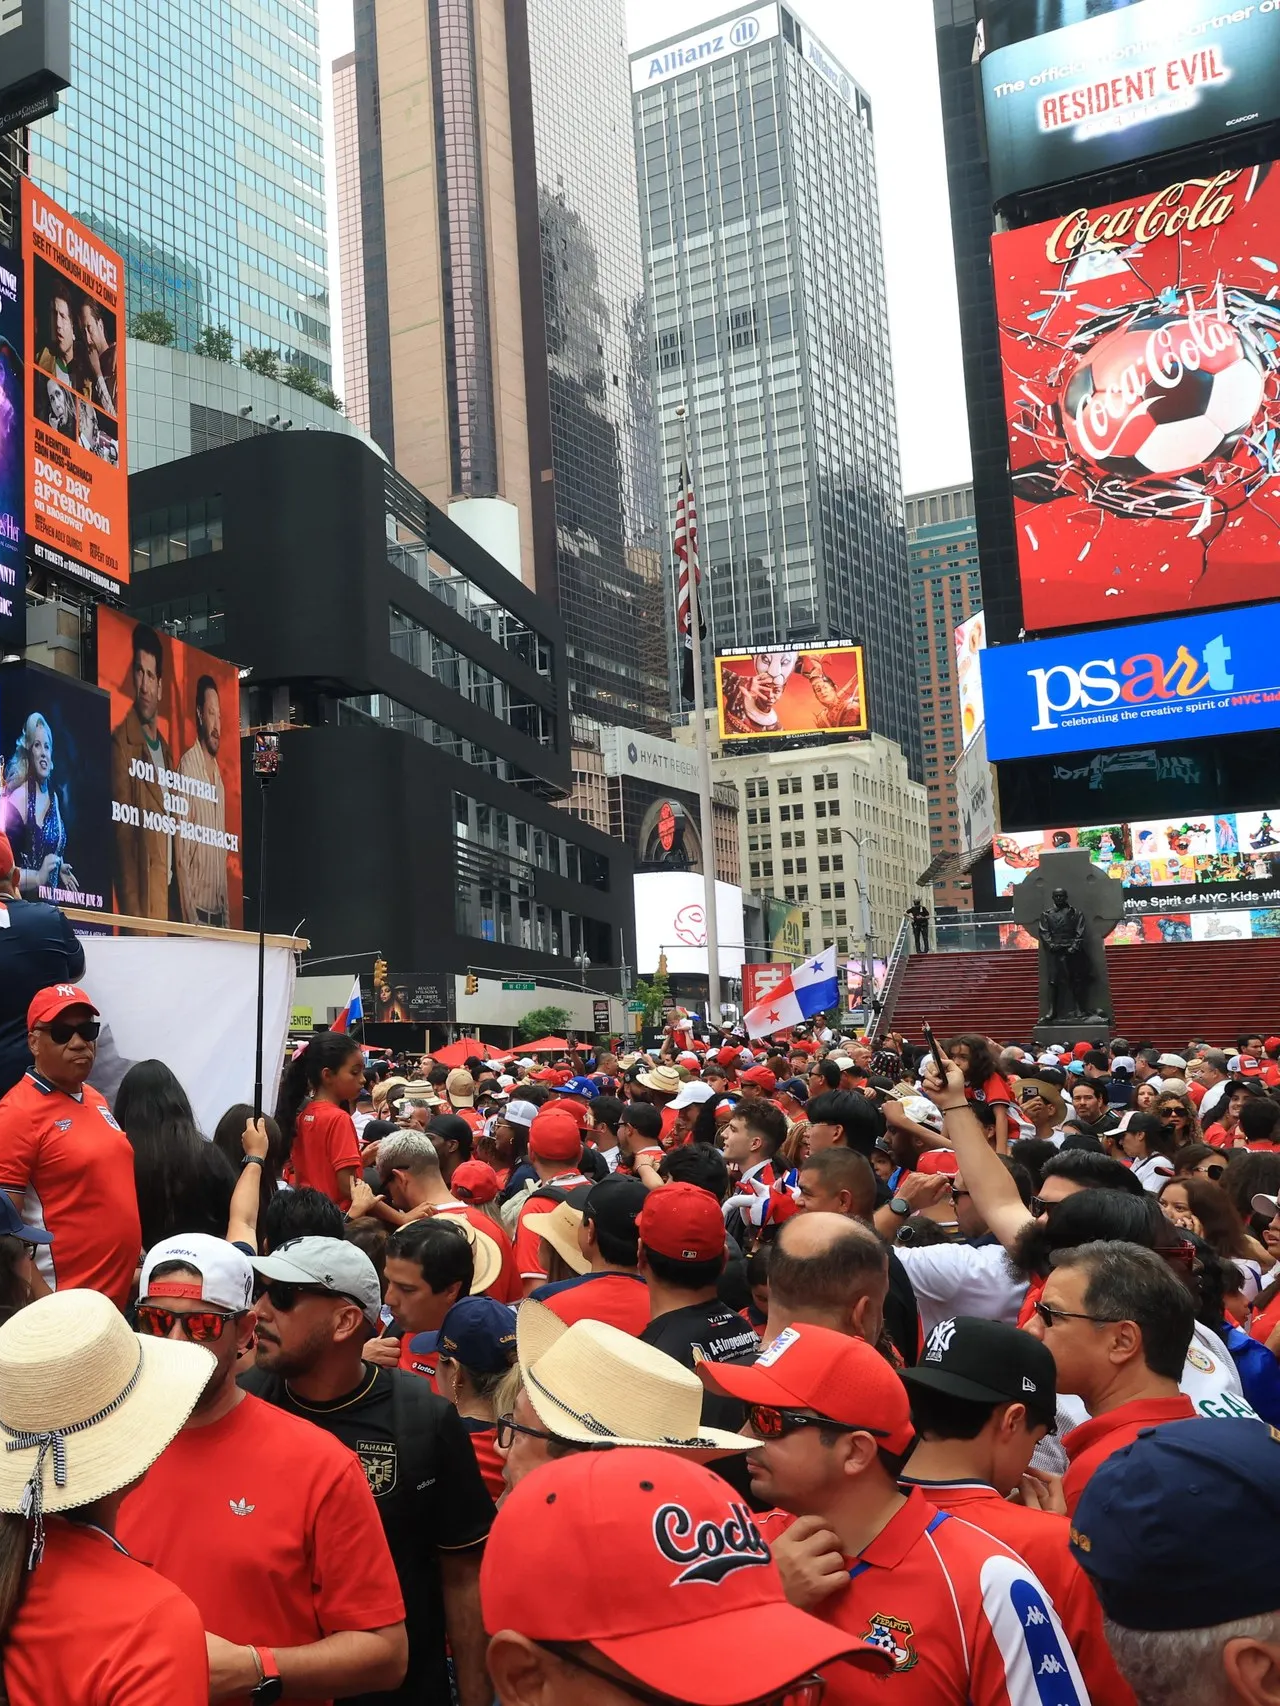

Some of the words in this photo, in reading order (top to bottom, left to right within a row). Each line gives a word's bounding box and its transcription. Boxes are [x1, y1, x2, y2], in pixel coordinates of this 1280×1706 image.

[647, 34, 725, 80] Allianz
[807, 39, 839, 89] Allianz
[993, 78, 1026, 99] The
[1041, 66, 1157, 129] RESIDENT
[1165, 48, 1224, 91] EVIL
[1045, 167, 1247, 265] Coca-Cola
[32, 199, 65, 248] LAST
[65, 227, 117, 292] CHANCE!
[32, 231, 44, 249] SEE
[52, 247, 82, 282] THROUGH
[80, 271, 96, 293] JULY
[95, 279, 104, 297] 12
[103, 288, 117, 308] ONLY
[1075, 300, 1233, 460] Coca-Cola
[35, 427, 45, 444] JON
[45, 433, 72, 460] BERNTHAL
[34, 441, 50, 459] EBON
[50, 448, 93, 484] MOSS-BACHRACH
[34, 457, 63, 488] DOG
[3, 512, 20, 544] Her
[34, 522, 55, 541] STEPHEN
[34, 543, 45, 558] GET
[44, 548, 64, 569] TICKETS
[732, 646, 747, 655] FROM
[768, 642, 785, 652] OFFICE
[1027, 634, 1236, 731] psart
[1061, 713, 1120, 729] celebrating
[1120, 708, 1139, 720] the
[1140, 704, 1184, 717] creative
[1185, 701, 1216, 713] spirit
[1217, 697, 1231, 708] of
[1231, 694, 1261, 708] NYC
[641, 750, 668, 769] HYATT
[39, 885, 53, 900] FINAL
[53, 888, 86, 905] PERFORMANCE
[86, 893, 96, 908] JUNE
[96, 895, 104, 908] 28
[1150, 894, 1182, 908] Spirit
[1184, 894, 1197, 905] of
[1199, 893, 1228, 904] NYC
[1230, 888, 1259, 902] Kids
[290, 1016, 312, 1026] CENTER
[875, 1616, 909, 1632] FEPAFUT
